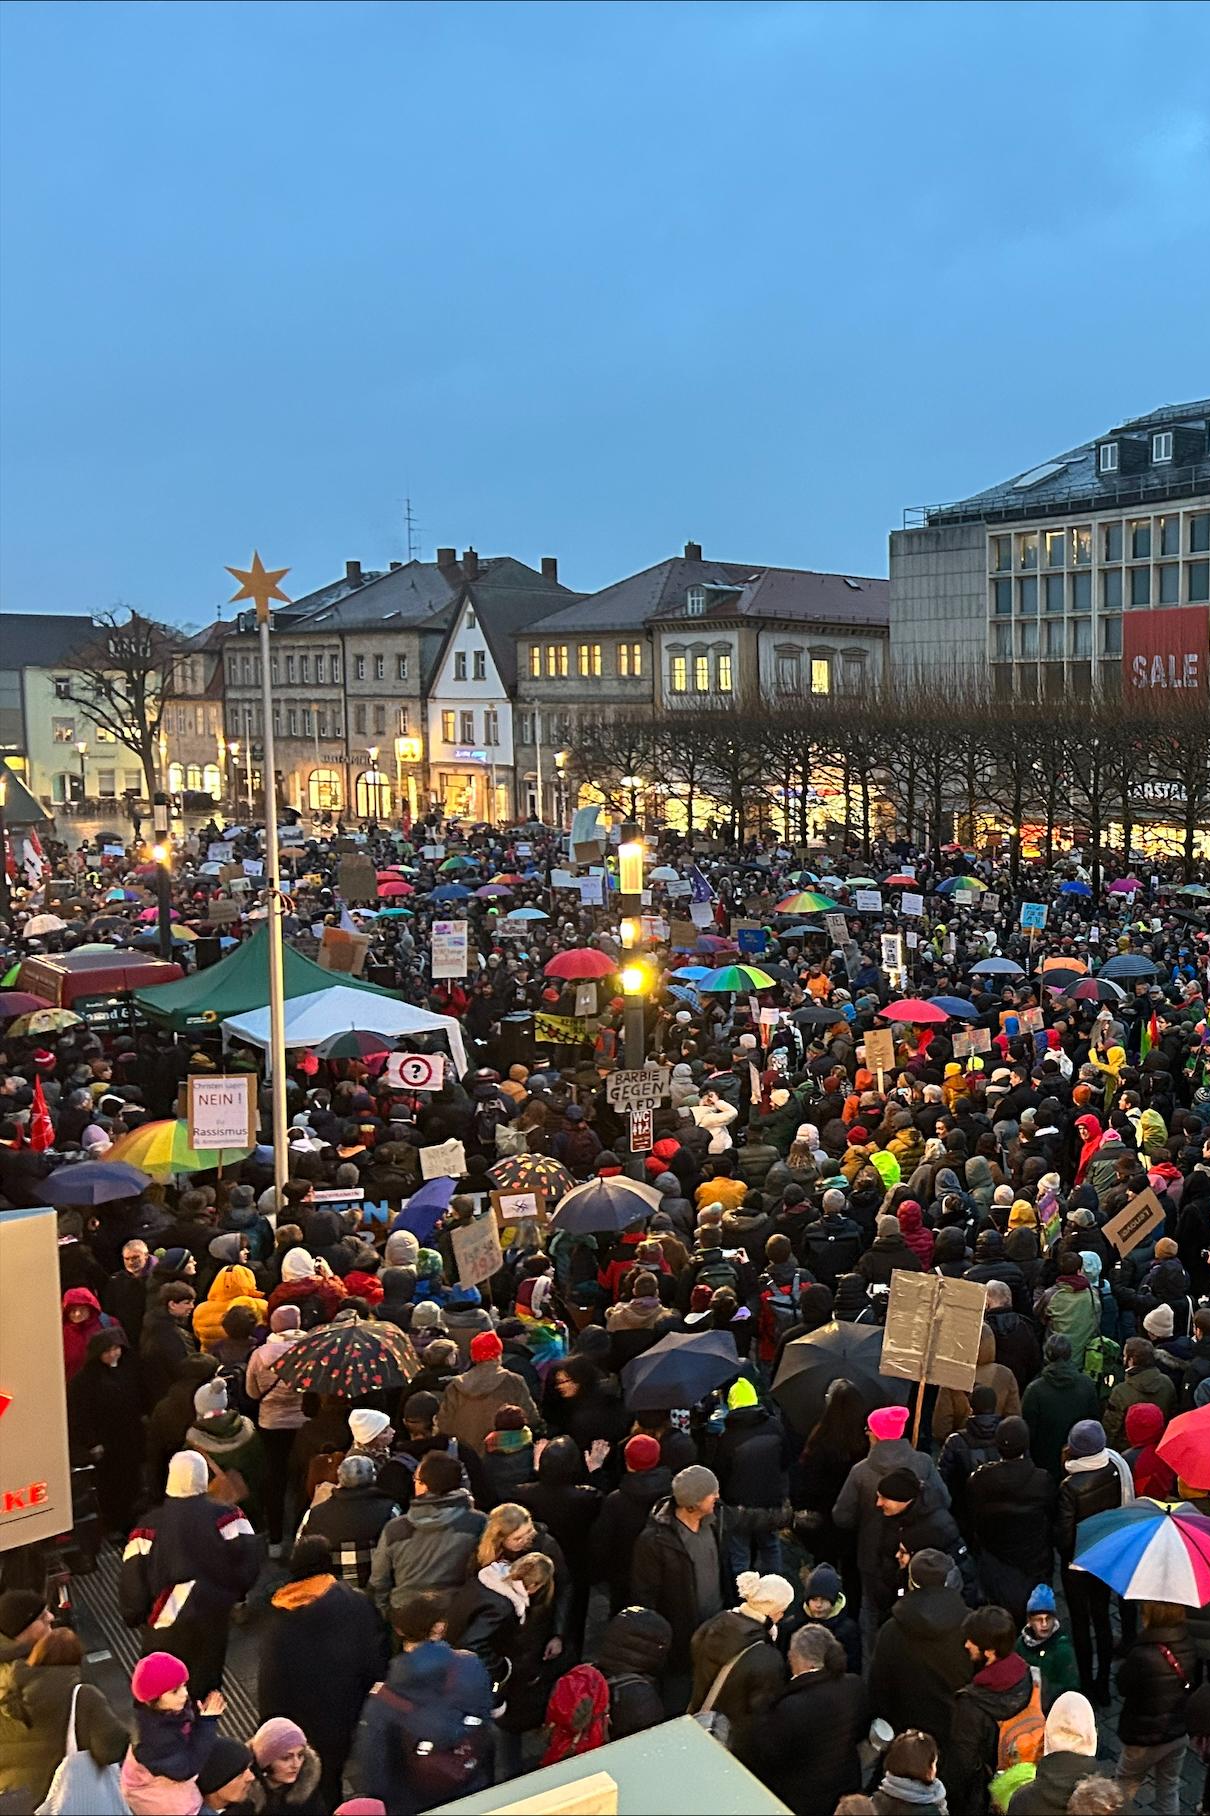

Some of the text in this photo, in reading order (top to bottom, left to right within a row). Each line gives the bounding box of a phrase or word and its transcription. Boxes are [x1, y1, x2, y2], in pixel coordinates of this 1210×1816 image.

[1132, 653, 1199, 688] SALE
[615, 1070, 660, 1084] BARBIE
[610, 1082, 665, 1100] GEGEN
[198, 1093, 233, 1106] NEIN
[632, 1110, 650, 1122] WC
[192, 1127, 248, 1137] Rassismus
